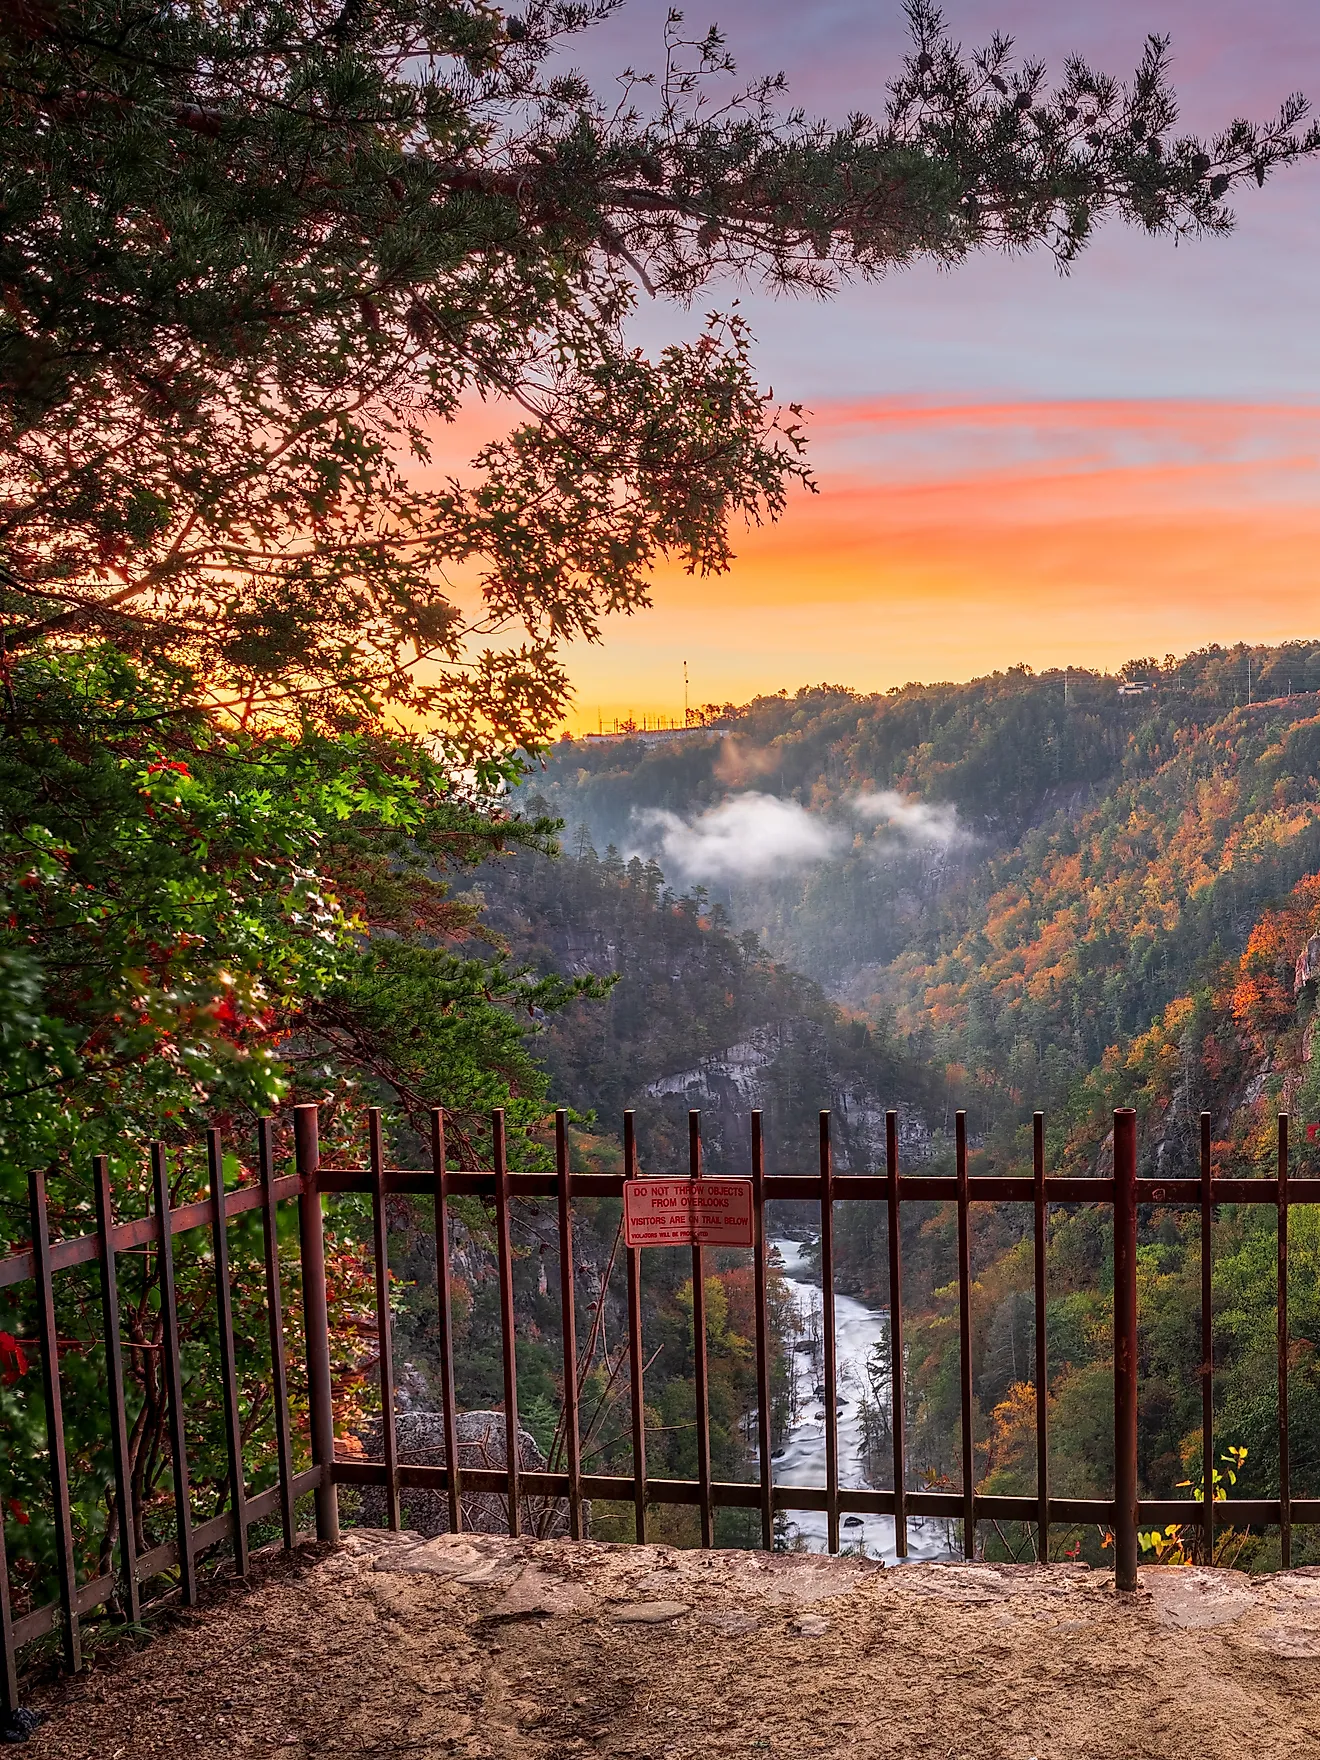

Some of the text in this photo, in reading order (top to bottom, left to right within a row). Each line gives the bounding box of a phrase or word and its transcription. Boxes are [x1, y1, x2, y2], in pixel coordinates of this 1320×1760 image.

[634, 1186, 744, 1197] DO NOT THROW OBJECTS
[651, 1197, 729, 1208] FROM OVERLOOKS
[630, 1215, 748, 1226] VISITORS ARE ON TRAIL BELOW
